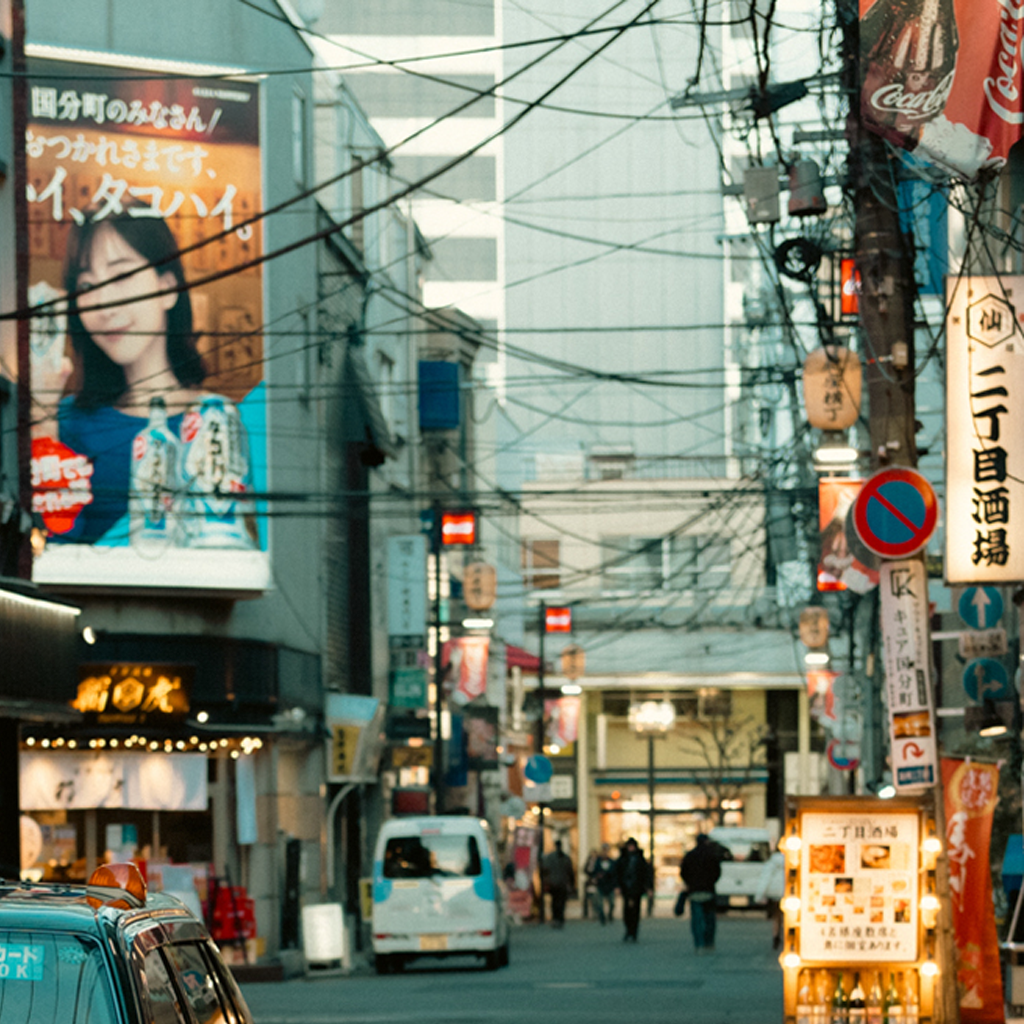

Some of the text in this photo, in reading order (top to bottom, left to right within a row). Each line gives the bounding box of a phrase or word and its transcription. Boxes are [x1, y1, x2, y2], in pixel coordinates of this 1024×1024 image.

[971, 366, 1010, 567] 二丁目酒場
